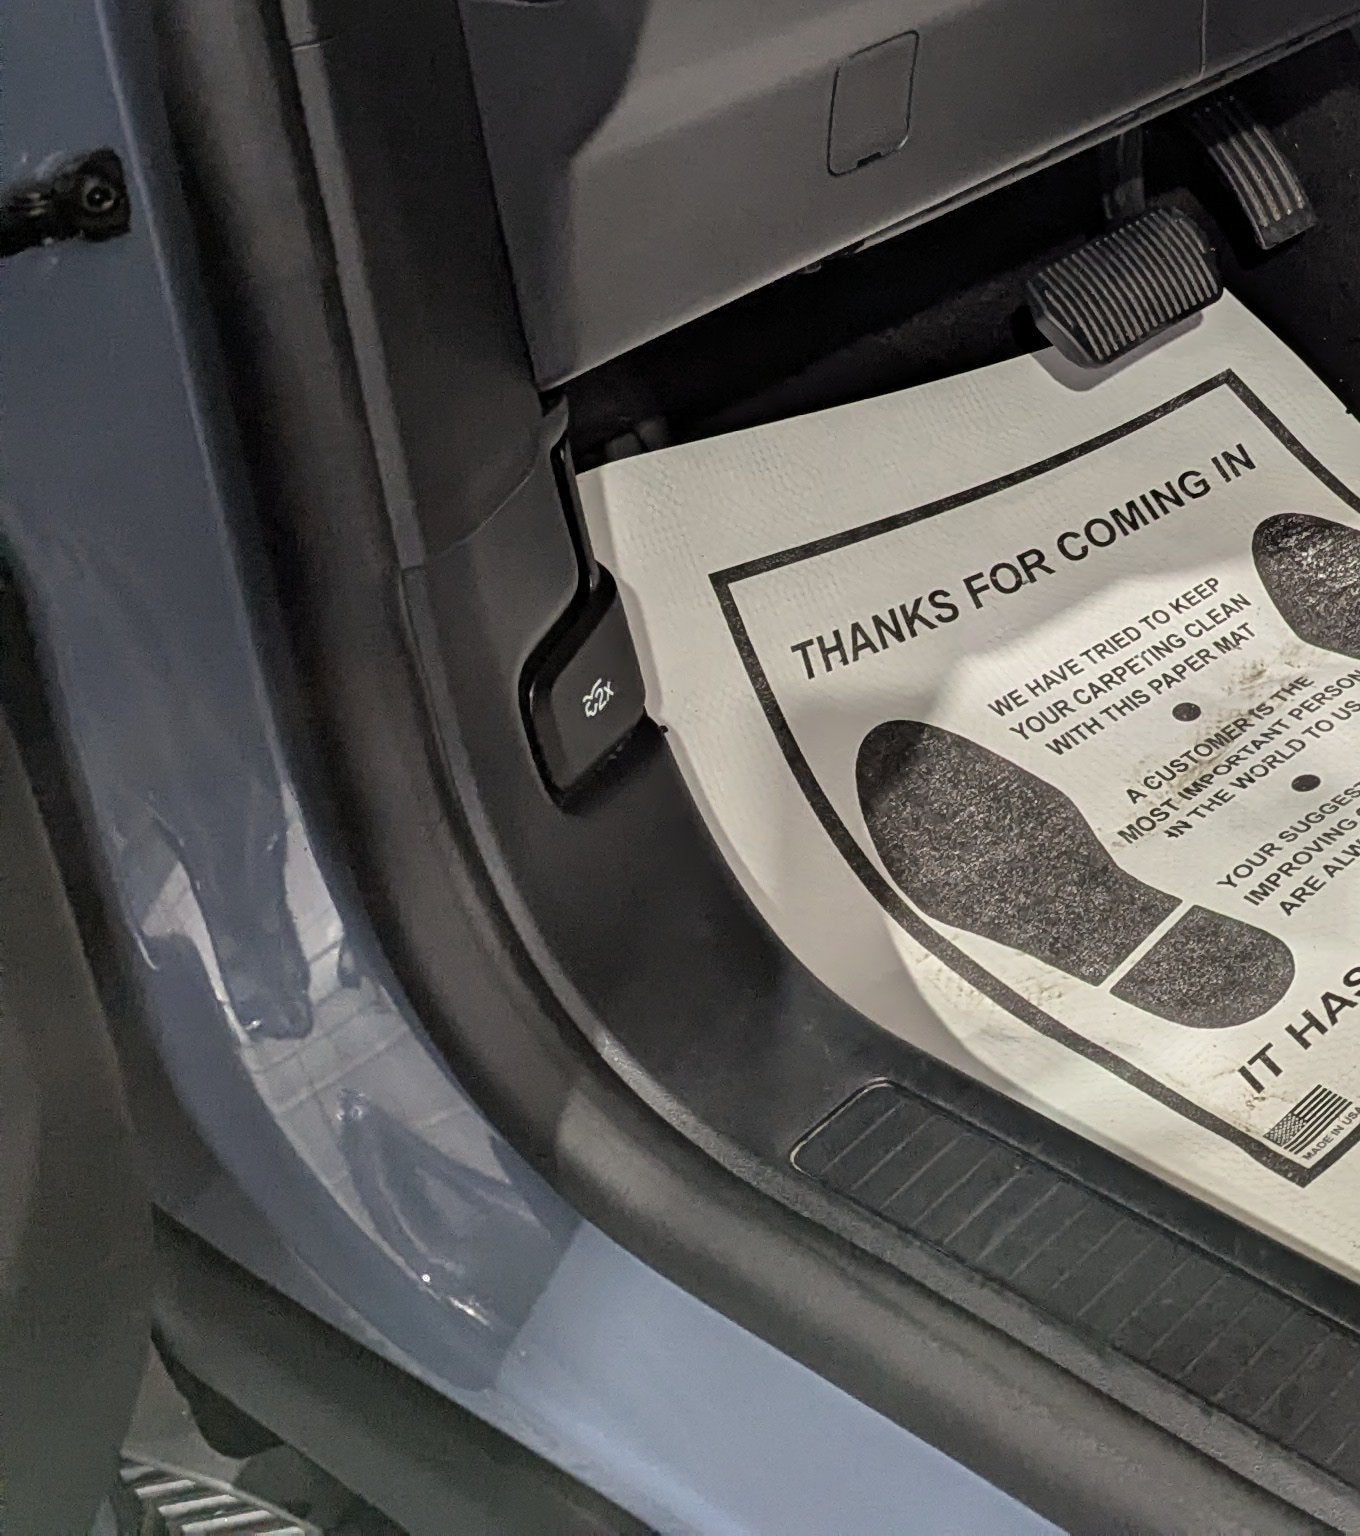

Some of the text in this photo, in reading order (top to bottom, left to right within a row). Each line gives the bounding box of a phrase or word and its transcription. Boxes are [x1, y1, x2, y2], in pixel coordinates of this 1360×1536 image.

[791, 443, 1258, 681] THANKS FOR COMING IN
[988, 577, 1220, 717] WE HAVE TRIED TO KEEP
[1009, 593, 1252, 741] YOUR CARPETING CLEAN
[1045, 622, 1256, 756] WITH THIS PAPER MAT
[1117, 798, 1180, 844] MOST
[1178, 718, 1291, 801] IMPORTANT
[1126, 675, 1315, 805] A CUSTOMER IS THE
[1164, 820, 1194, 840] IN
[1186, 788, 1237, 819] THE
[1229, 738, 1307, 791] WORLD
[1301, 719, 1335, 739] TO
[1216, 842, 1283, 891] YOUR
[1243, 818, 1358, 906] IMPROVING
[1279, 875, 1328, 917] ARE
[1236, 1041, 1284, 1095] IT
[1302, 1134, 1335, 1161] MADE
[1330, 1124, 1346, 1137] IN
